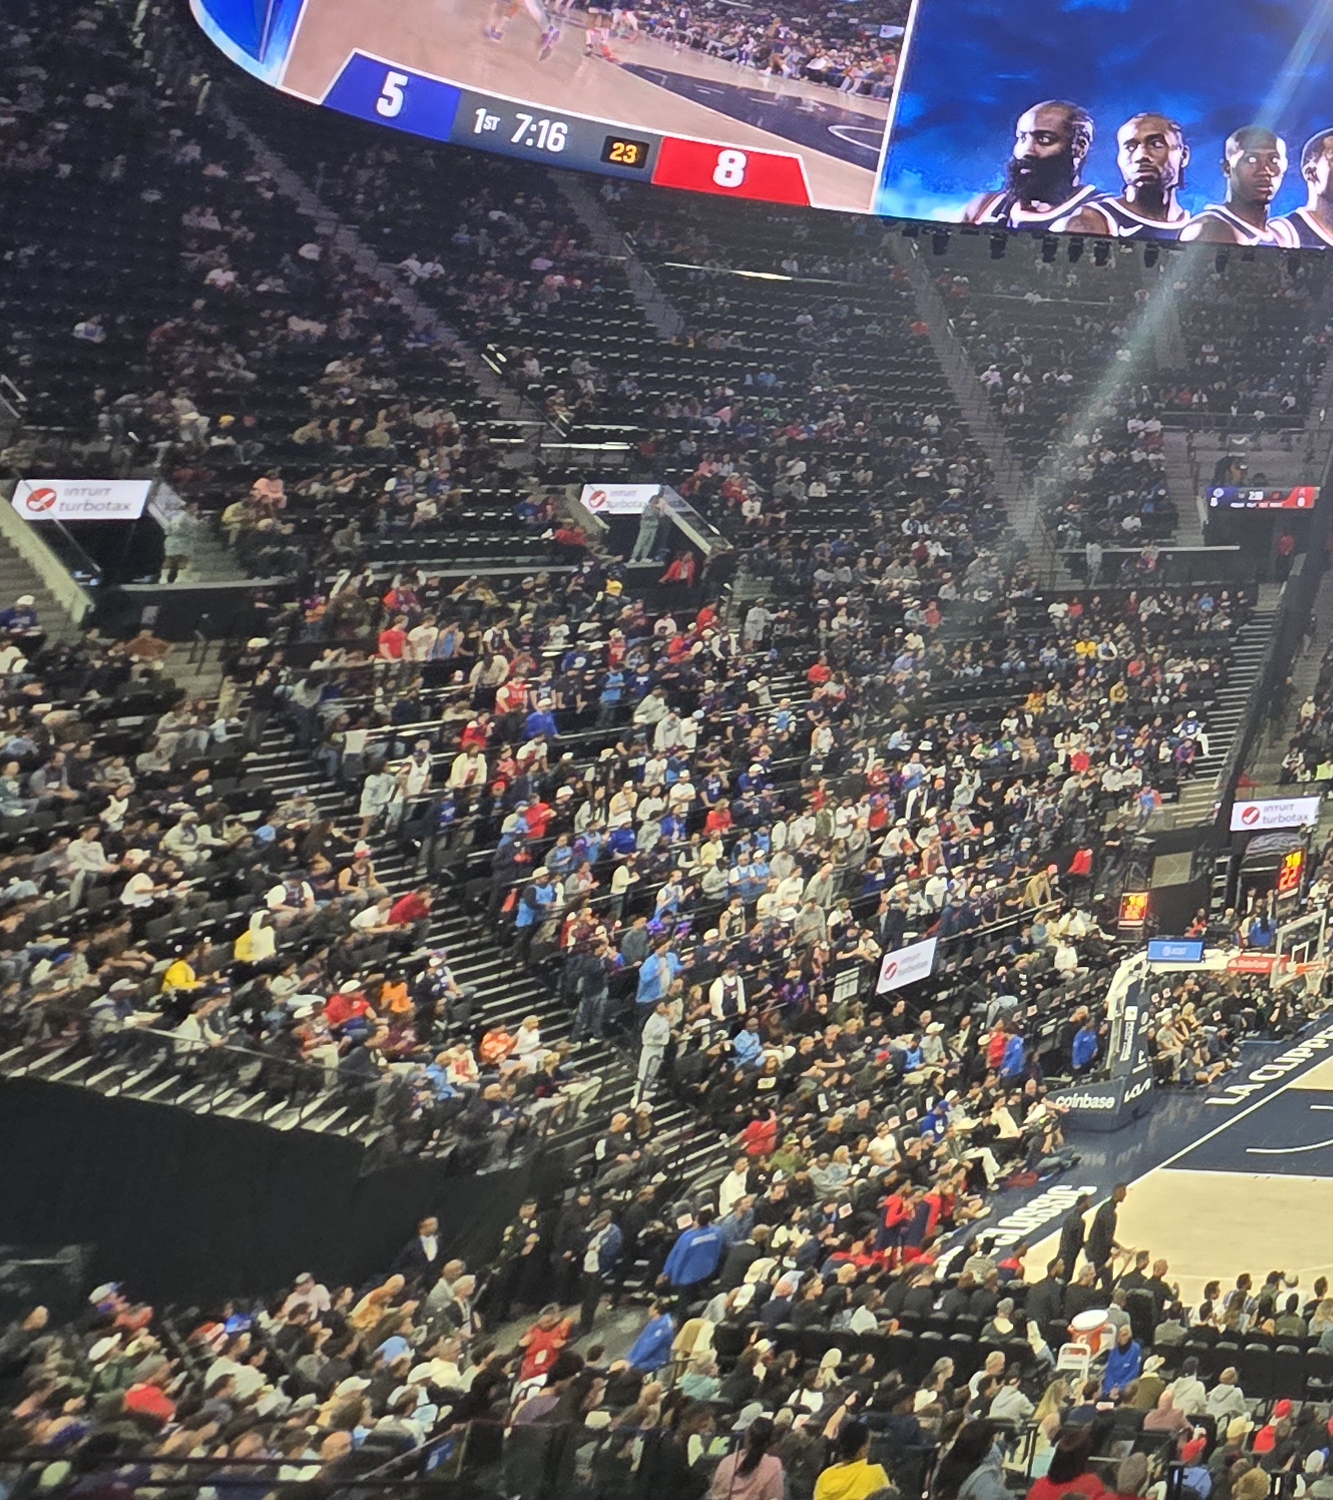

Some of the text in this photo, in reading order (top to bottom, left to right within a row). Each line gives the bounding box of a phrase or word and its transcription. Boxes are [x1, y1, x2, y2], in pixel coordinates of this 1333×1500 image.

[376, 71, 747, 188] 5 1ST 7:16 23 8
[1056, 1093, 1115, 1109] coinbase
[1205, 1083, 1265, 1104] LA
